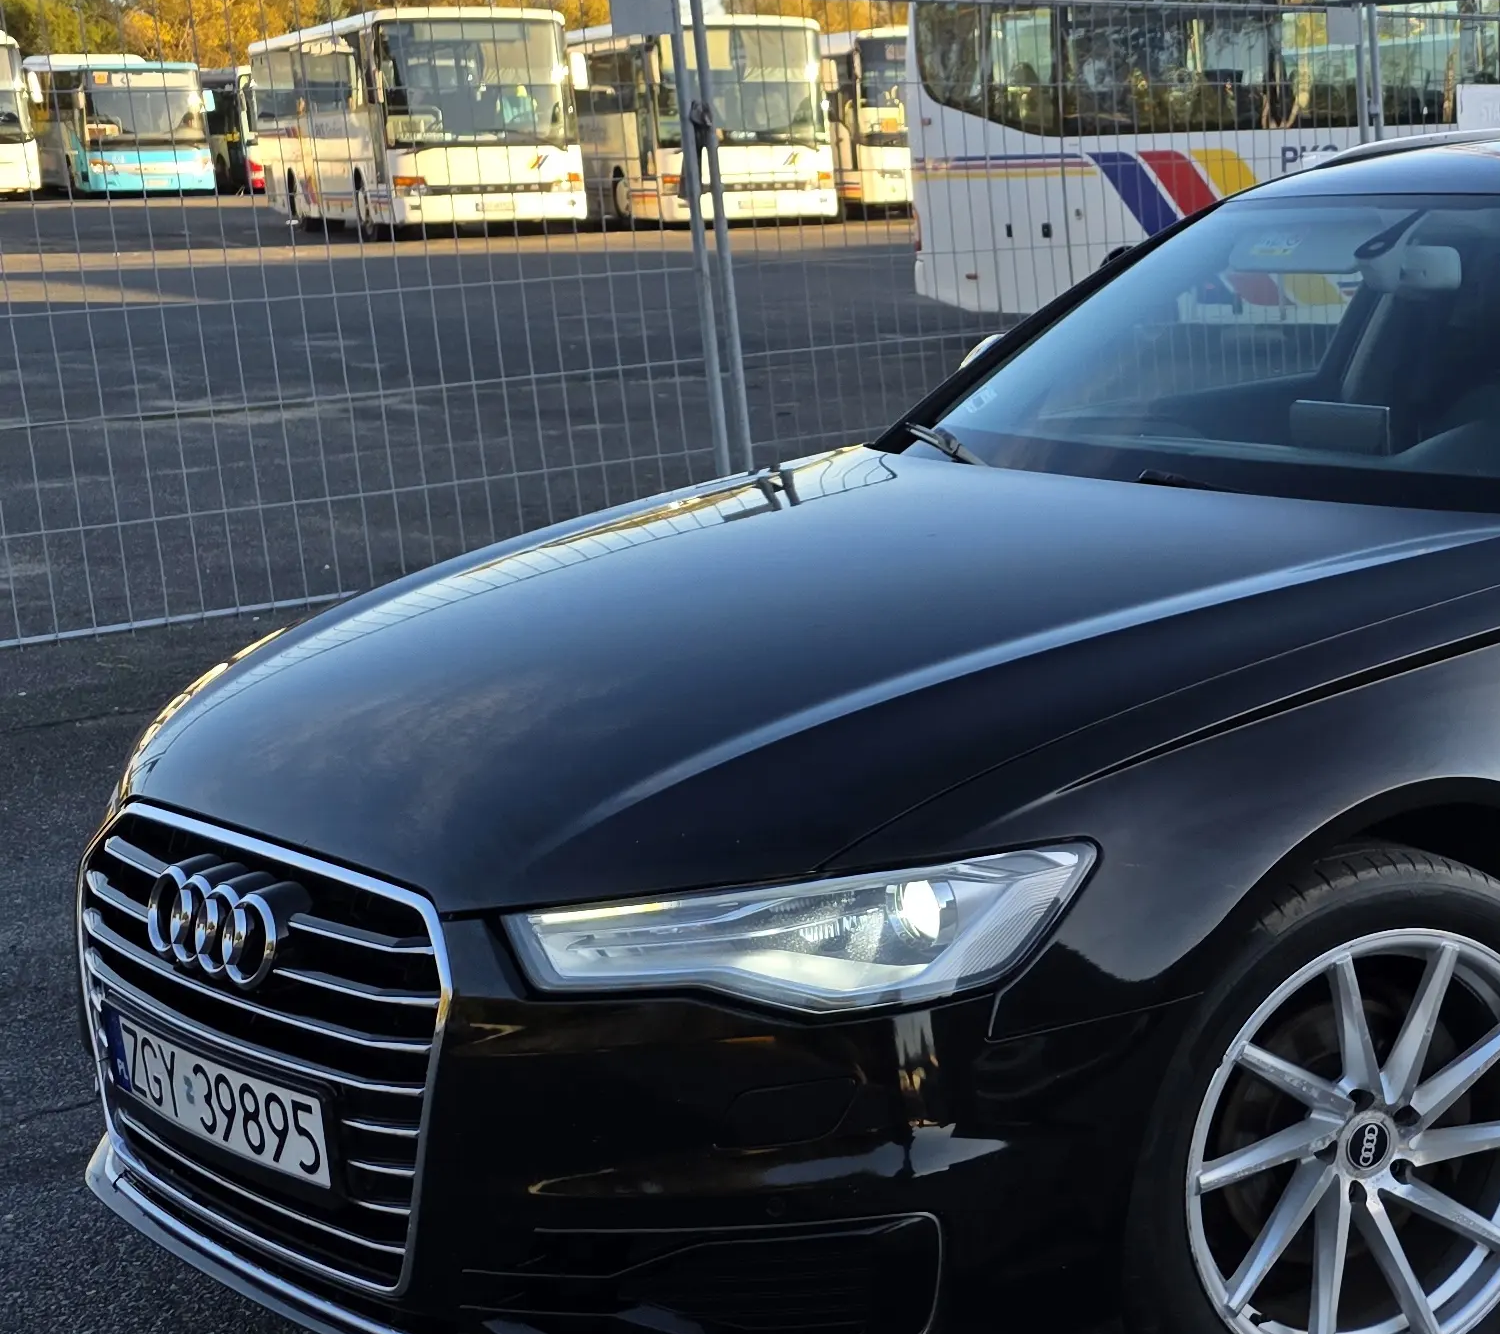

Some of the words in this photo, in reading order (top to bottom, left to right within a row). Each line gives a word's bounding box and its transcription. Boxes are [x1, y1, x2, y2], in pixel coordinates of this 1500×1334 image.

[116, 1058, 129, 1081] PL
[121, 1023, 178, 1119] ZGY
[192, 1064, 321, 1175] 39895
